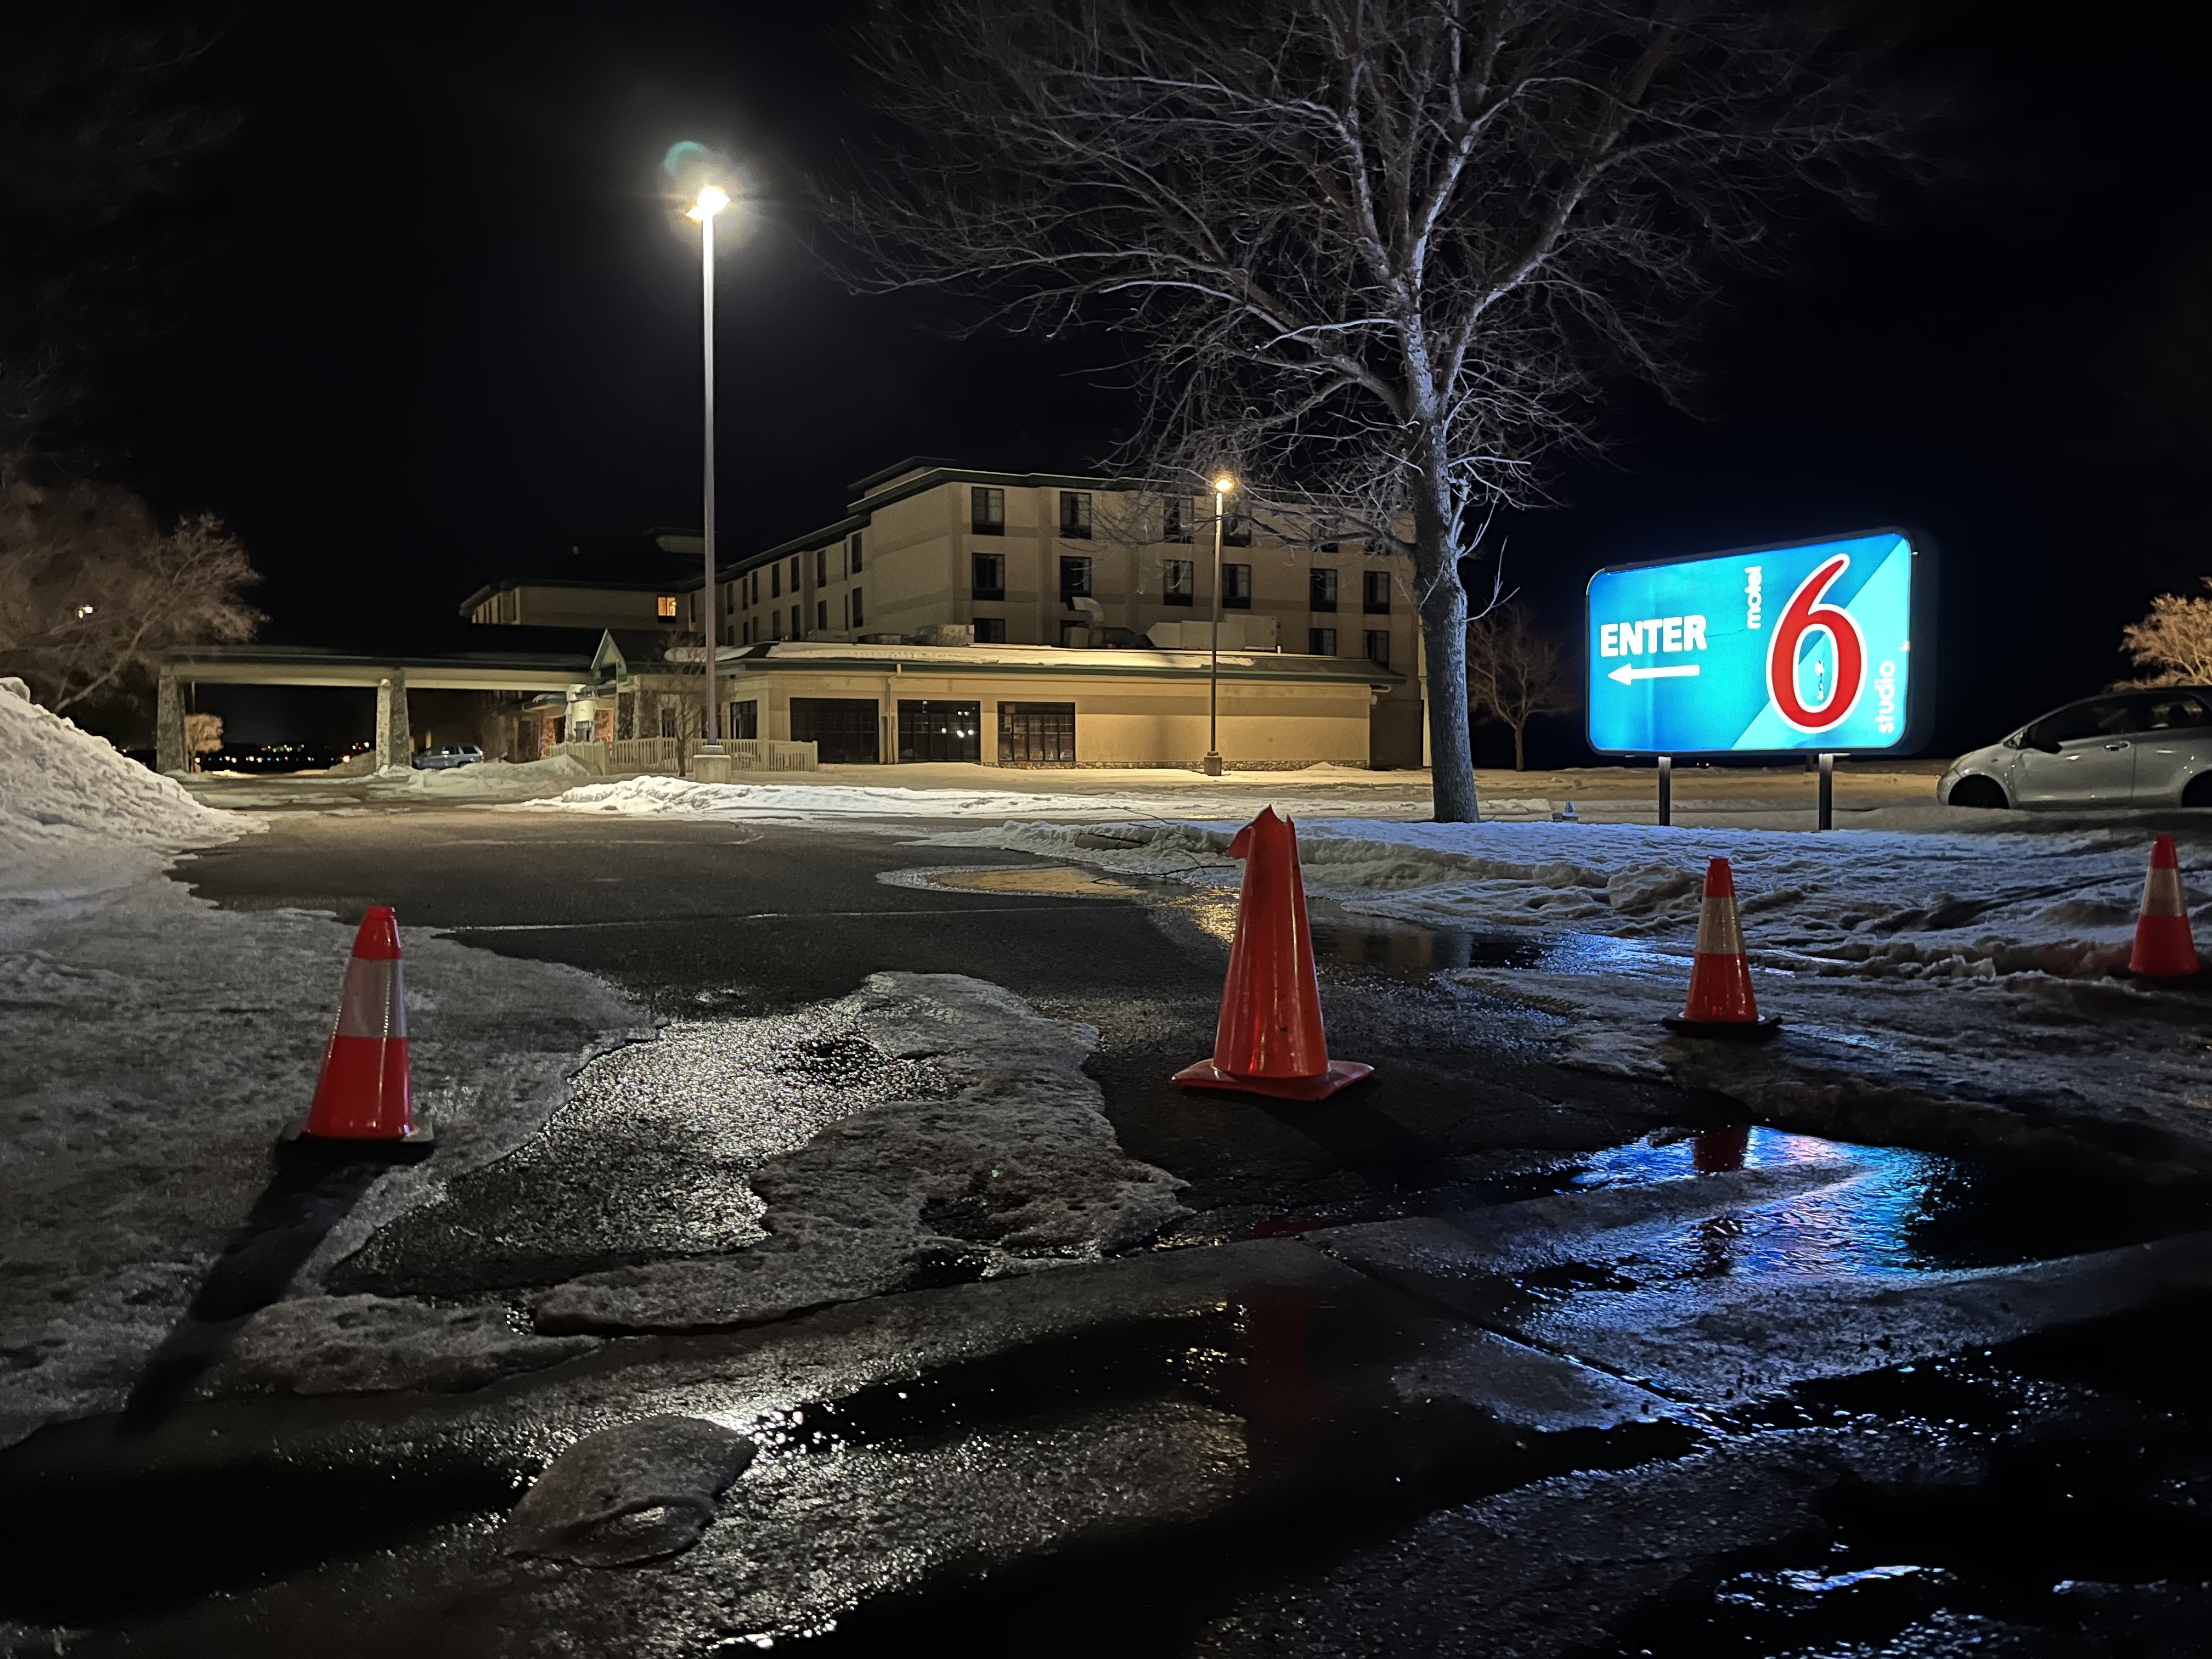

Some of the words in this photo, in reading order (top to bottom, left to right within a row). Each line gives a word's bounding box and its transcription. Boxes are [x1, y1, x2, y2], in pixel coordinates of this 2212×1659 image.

[1600, 615, 1707, 657] ENTER
[1744, 566, 1762, 629] motel
[1766, 553, 1867, 733] 6
[1874, 661, 1895, 734] studio
